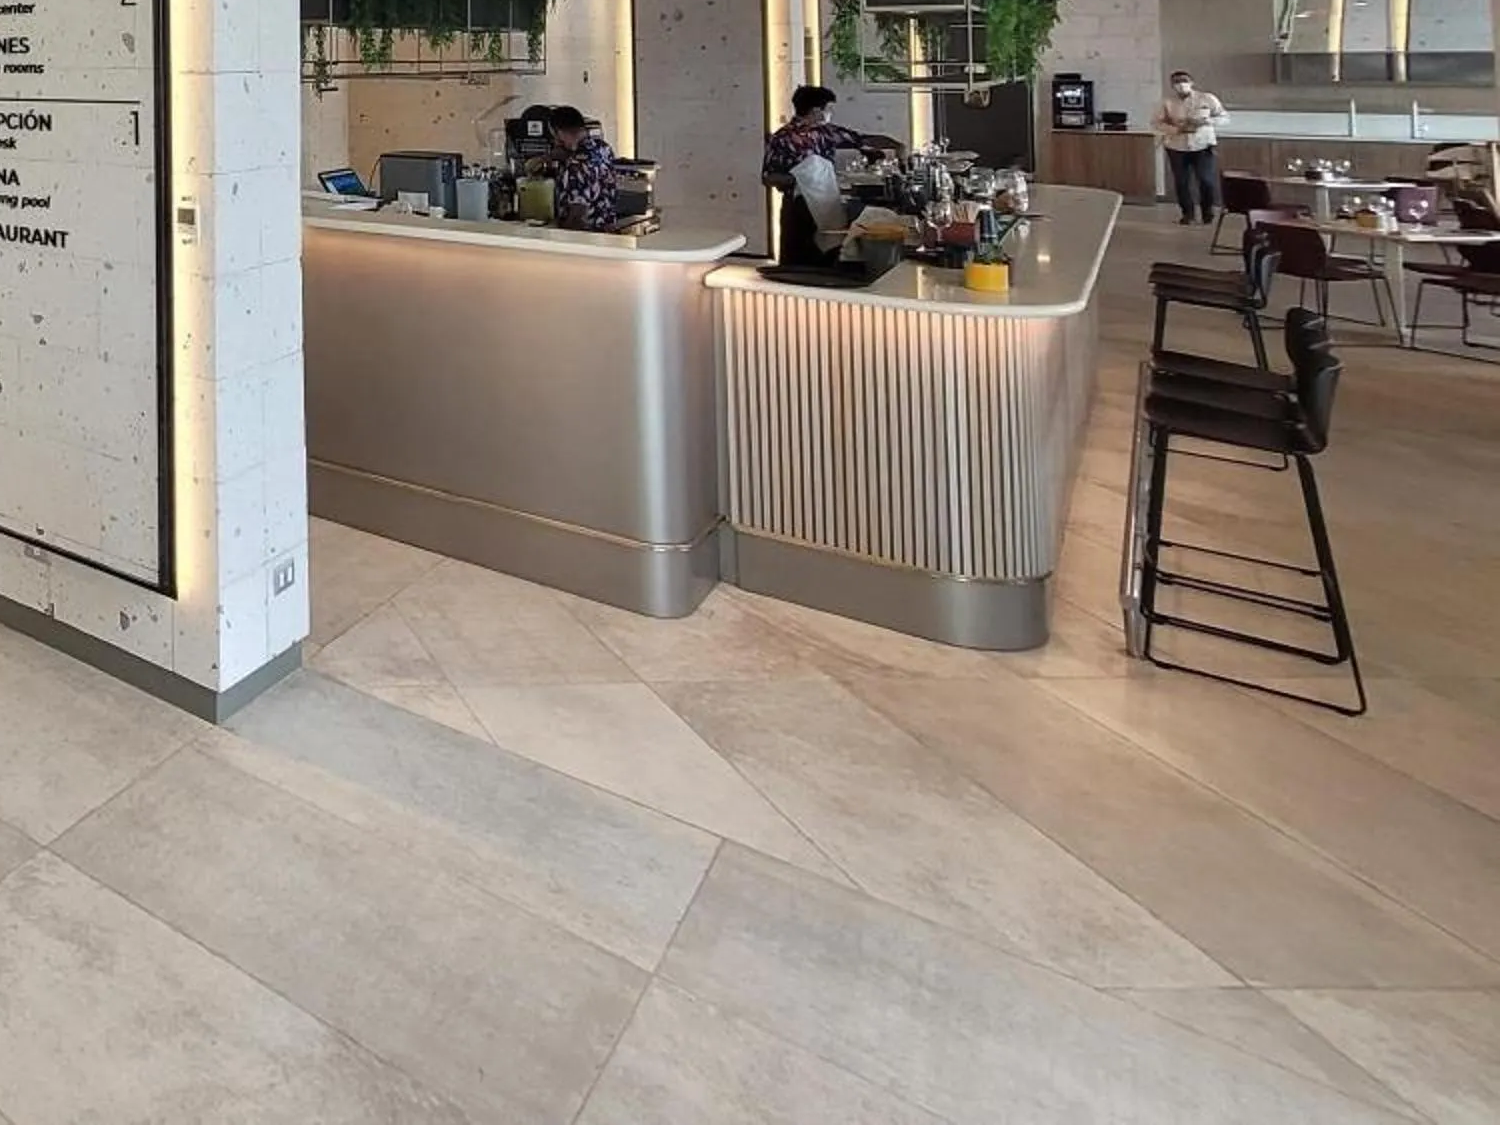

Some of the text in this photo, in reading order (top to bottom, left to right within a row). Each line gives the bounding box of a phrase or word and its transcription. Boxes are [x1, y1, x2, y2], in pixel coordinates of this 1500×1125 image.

[3, 63, 45, 74] rooms
[130, 110, 140, 146] 1
[21, 195, 51, 209] pool
